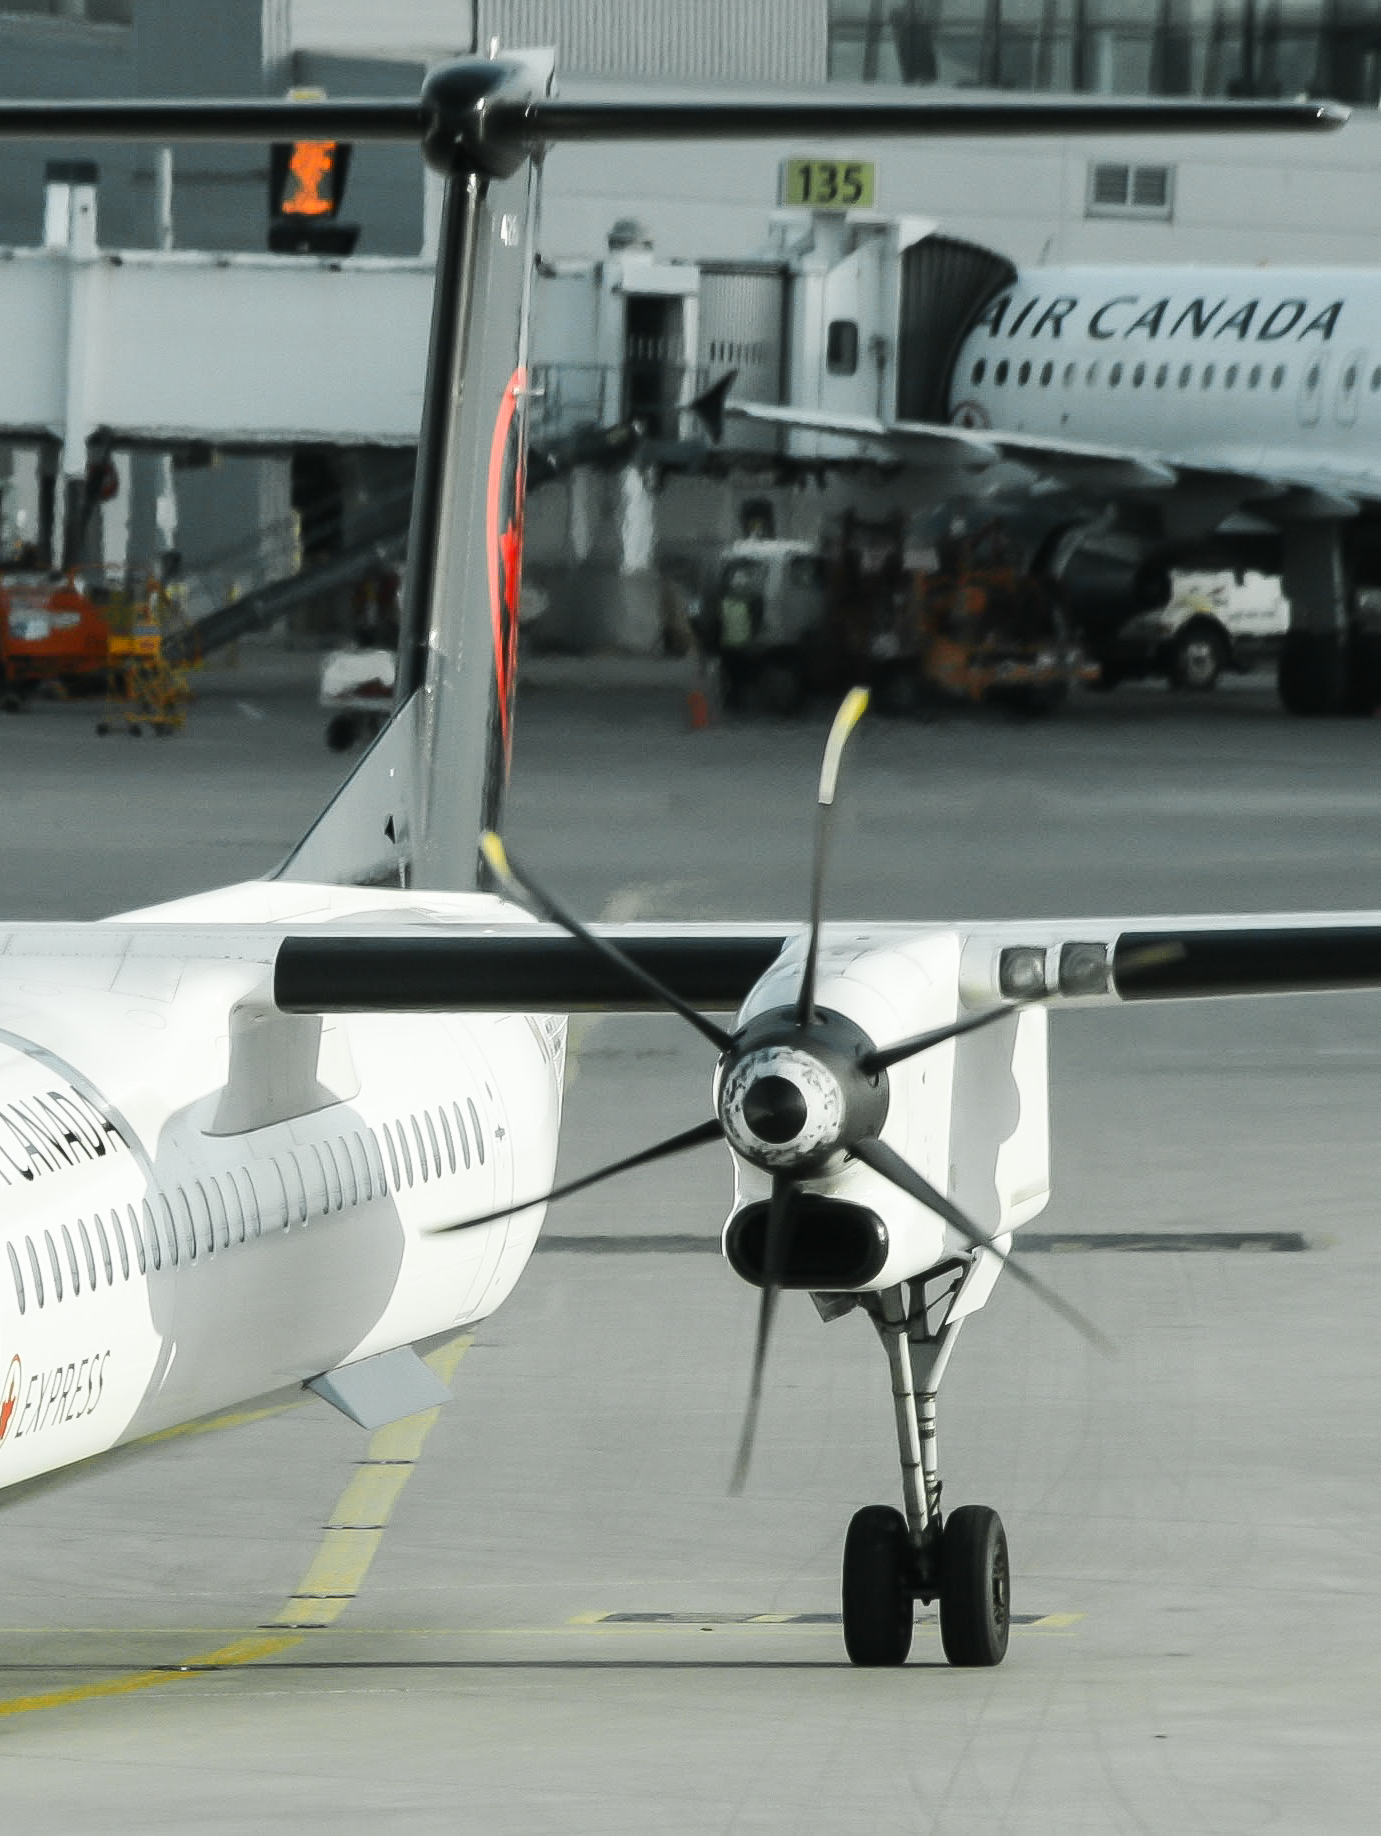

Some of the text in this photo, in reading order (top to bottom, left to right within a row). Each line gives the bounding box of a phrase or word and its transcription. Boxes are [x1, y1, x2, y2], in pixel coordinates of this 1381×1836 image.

[799, 163, 864, 205] 135
[974, 295, 1345, 342] AIR CANADA
[14, 1348, 112, 1439] EXPRESS
